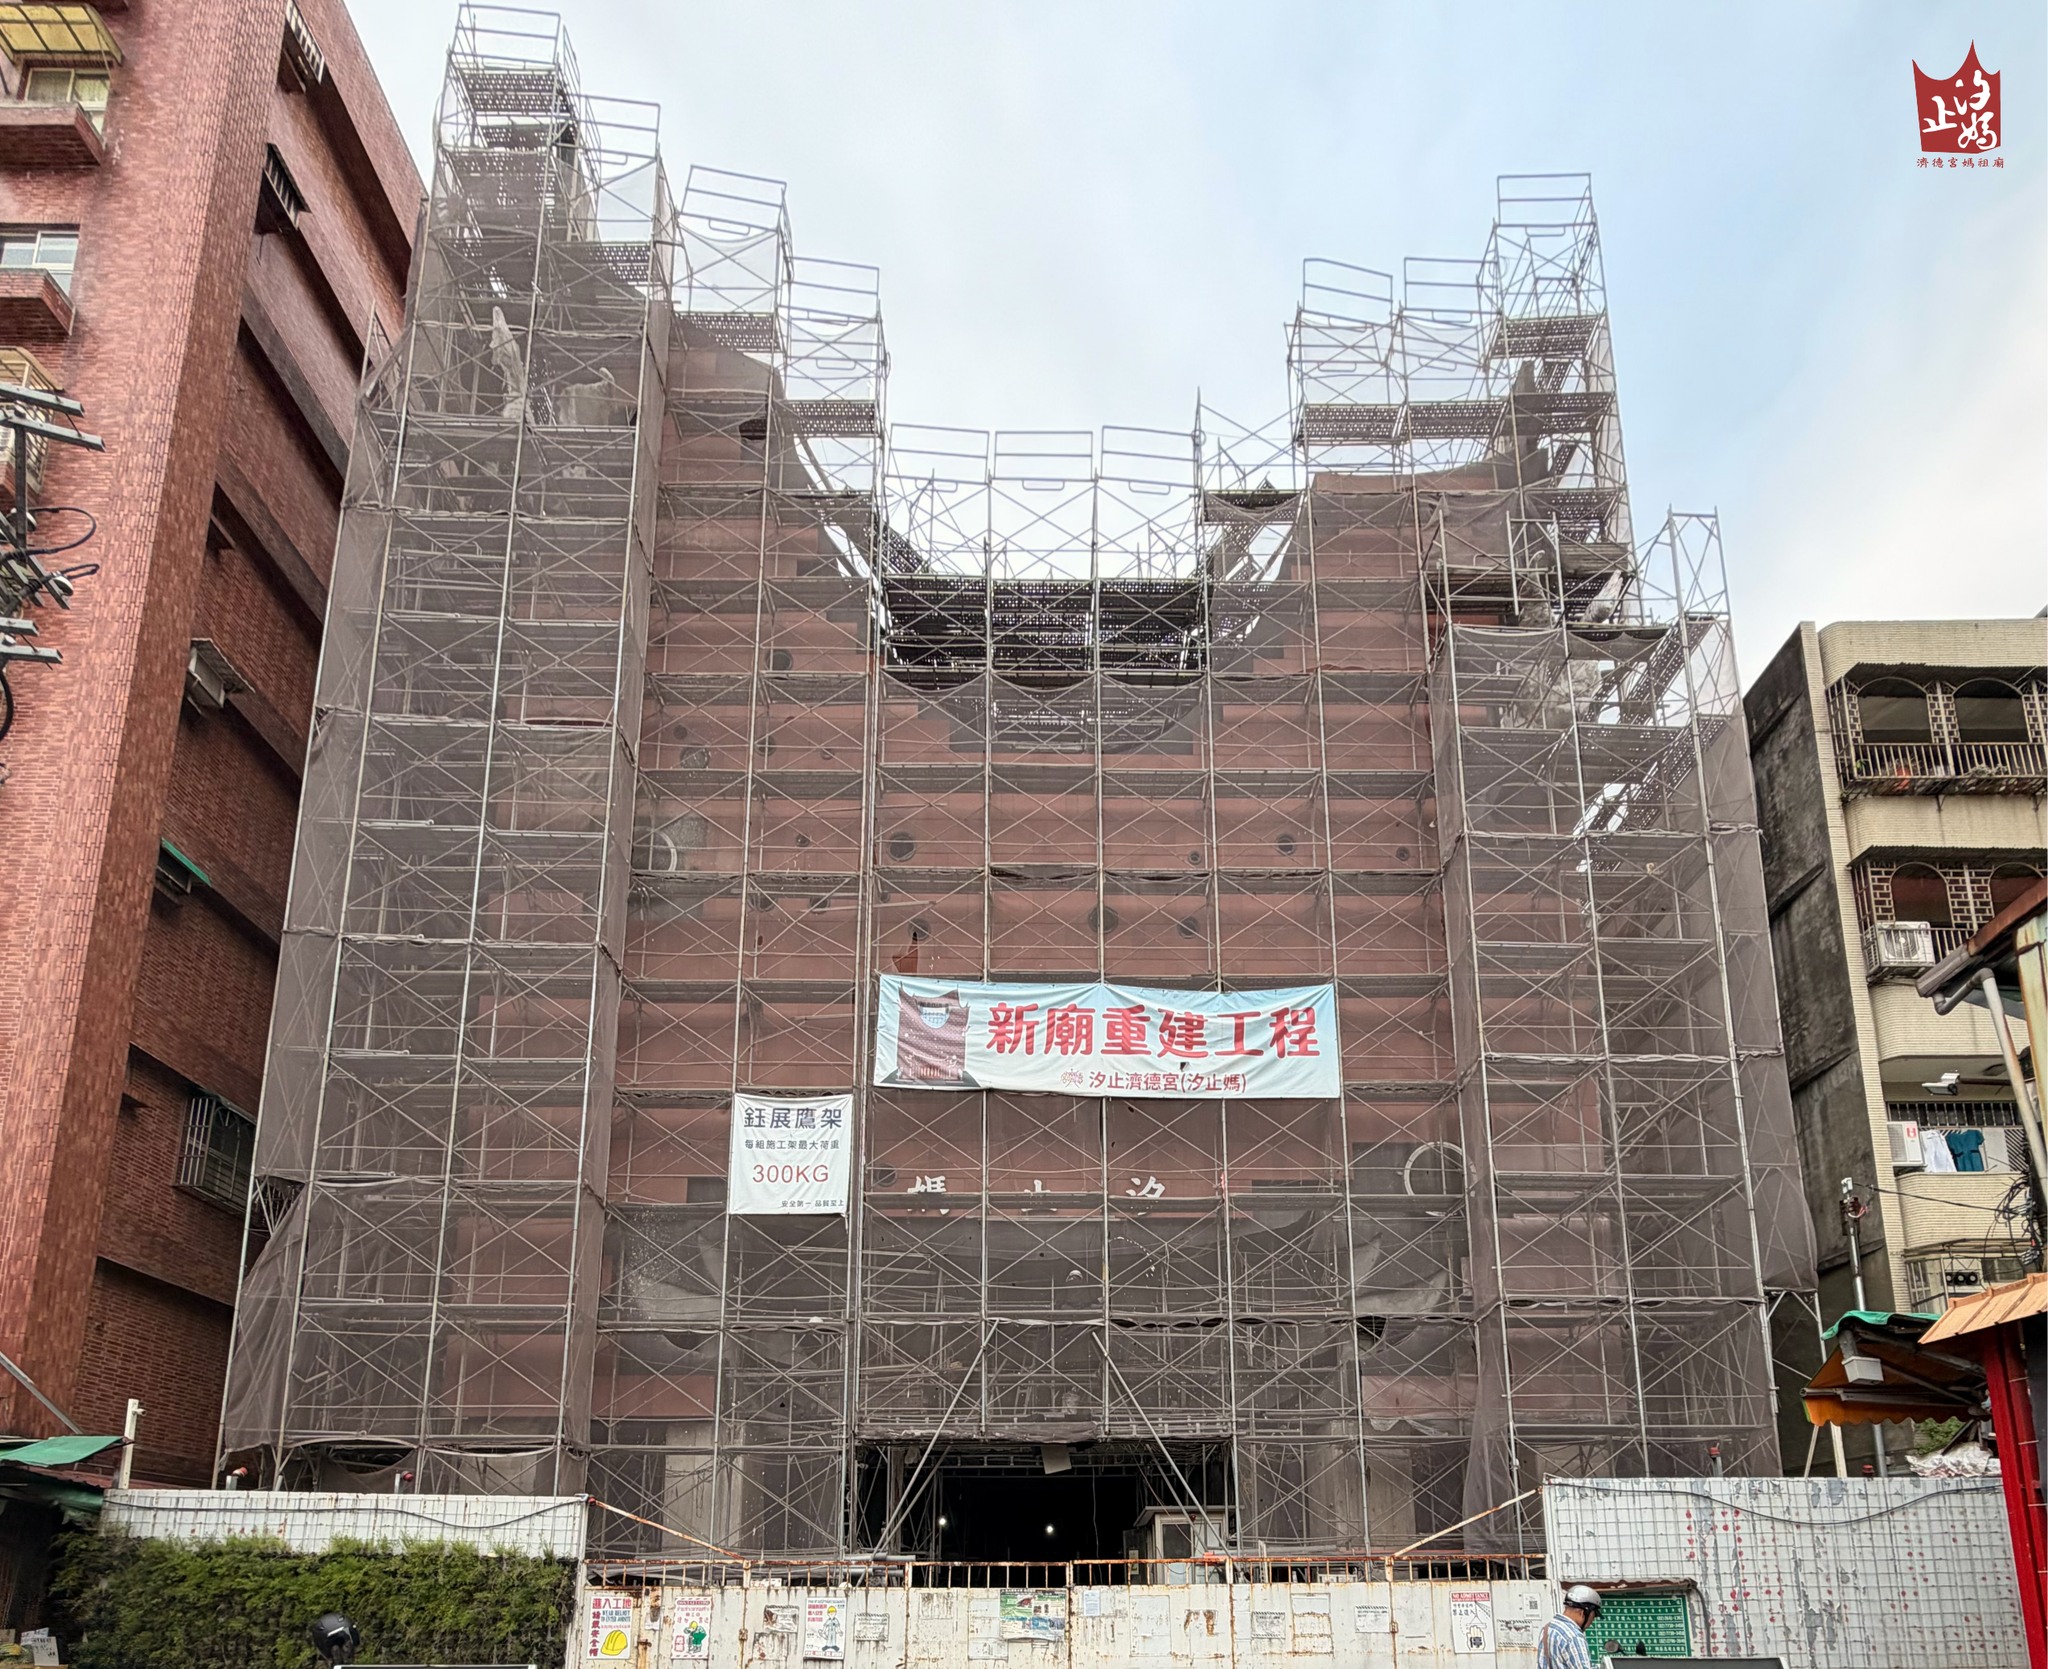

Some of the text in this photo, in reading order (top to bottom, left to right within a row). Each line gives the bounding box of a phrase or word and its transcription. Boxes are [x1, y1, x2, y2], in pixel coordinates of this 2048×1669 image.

[985, 1000, 1321, 1059] 新廟重建工程
[1088, 1069, 1247, 1093] 汐止濟德宮(汐止媽)
[743, 1107, 842, 1130] 鈺展鷹架
[744, 1139, 840, 1151] 每組施工架最大荷重
[752, 1164, 829, 1184] 300KG
[592, 1598, 632, 1610] 進入工地
